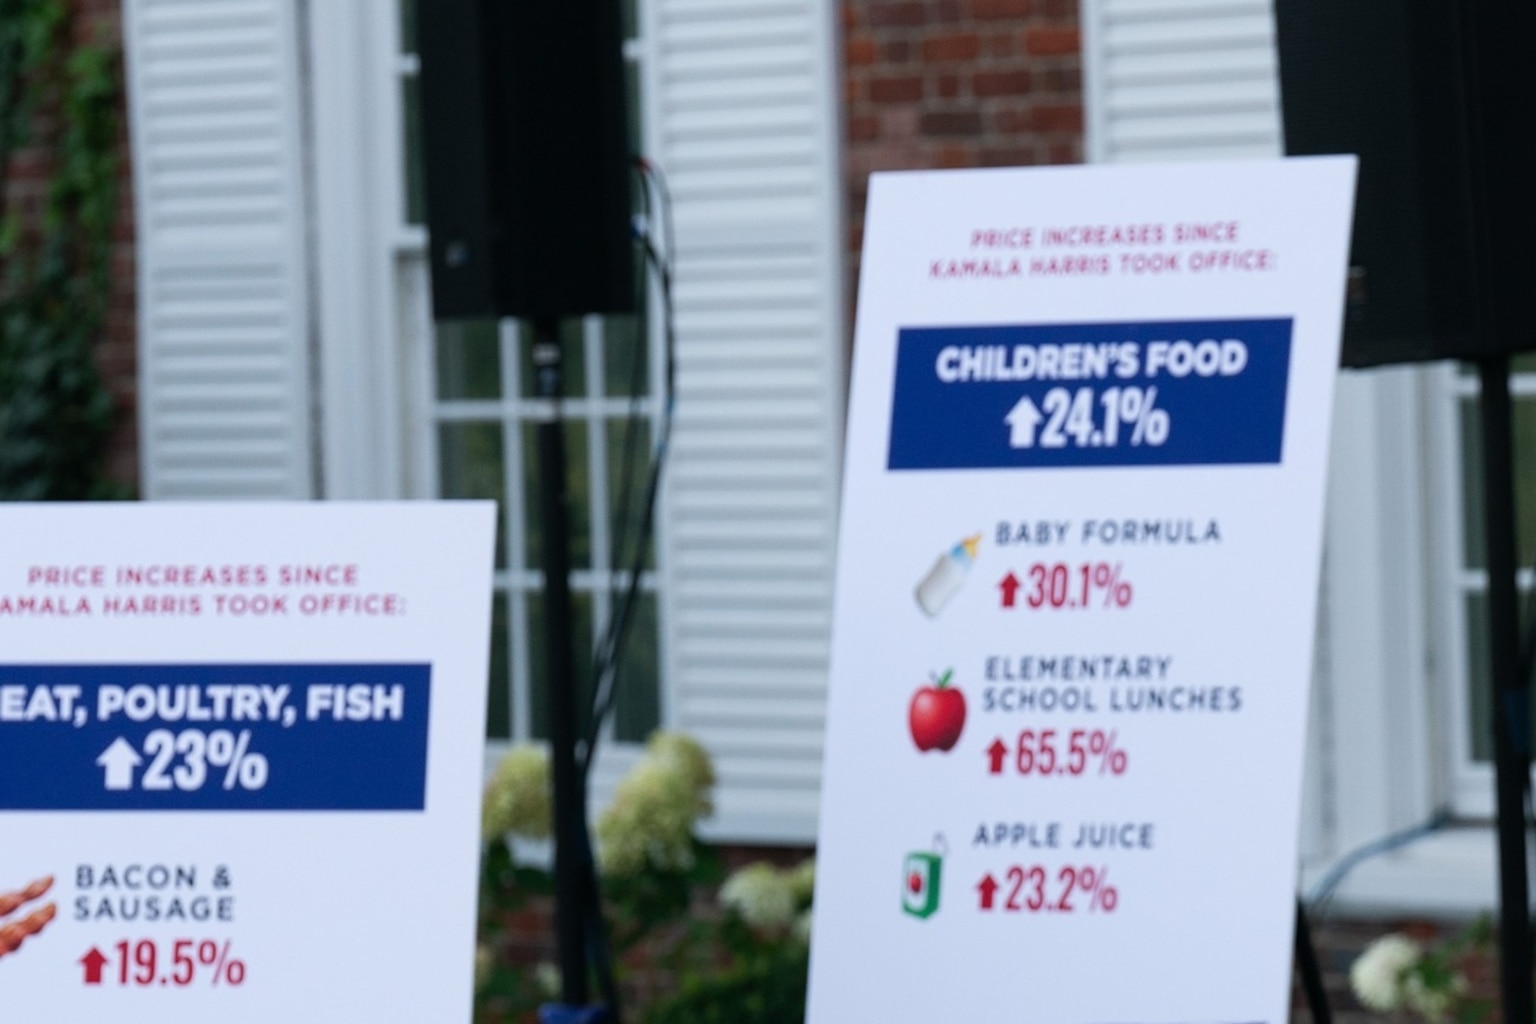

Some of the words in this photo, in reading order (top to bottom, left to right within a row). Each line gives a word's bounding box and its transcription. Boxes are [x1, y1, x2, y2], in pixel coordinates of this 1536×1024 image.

[970, 227, 1033, 249] PRICE
[1042, 224, 1165, 246] INCREASES
[1174, 221, 1237, 243] SINCE
[930, 259, 1021, 277] KAMALA
[1030, 255, 1110, 275] HARRIS
[1120, 253, 1179, 274] TOOK
[1188, 249, 1277, 273] OFFICE:
[936, 342, 1139, 382] CHILDREN'S
[1146, 340, 1248, 377] FOOD
[1042, 386, 1169, 448] 24.1%
[996, 521, 1069, 546] BABY
[1082, 520, 1220, 544] FORMULA
[28, 566, 104, 587] PRICE
[117, 566, 267, 586] INCREASES
[279, 565, 356, 585] SINCE
[1027, 563, 1132, 609] 30.1%
[0, 597, 91, 615] AMALA
[103, 595, 202, 615] HARRIS
[216, 595, 287, 615] TOOK
[299, 594, 406, 615] OFFICE:
[985, 656, 1170, 681] ELEMENTARY
[0, 685, 87, 727] EAT,
[97, 685, 296, 727] POULTRY,
[306, 684, 404, 720] FISH
[983, 687, 1096, 712] SCHOOL
[1110, 687, 1242, 712] LUNCHES
[142, 729, 268, 790] 23%
[1016, 729, 1127, 776] 65.5%
[973, 823, 1059, 848] APPLE
[1073, 823, 1153, 849] JUICE
[76, 865, 196, 889] BACON
[213, 866, 231, 889] &
[1004, 865, 1117, 912] 23.2%
[75, 896, 232, 921] SAUSAGE
[114, 938, 246, 987] 19.5%
